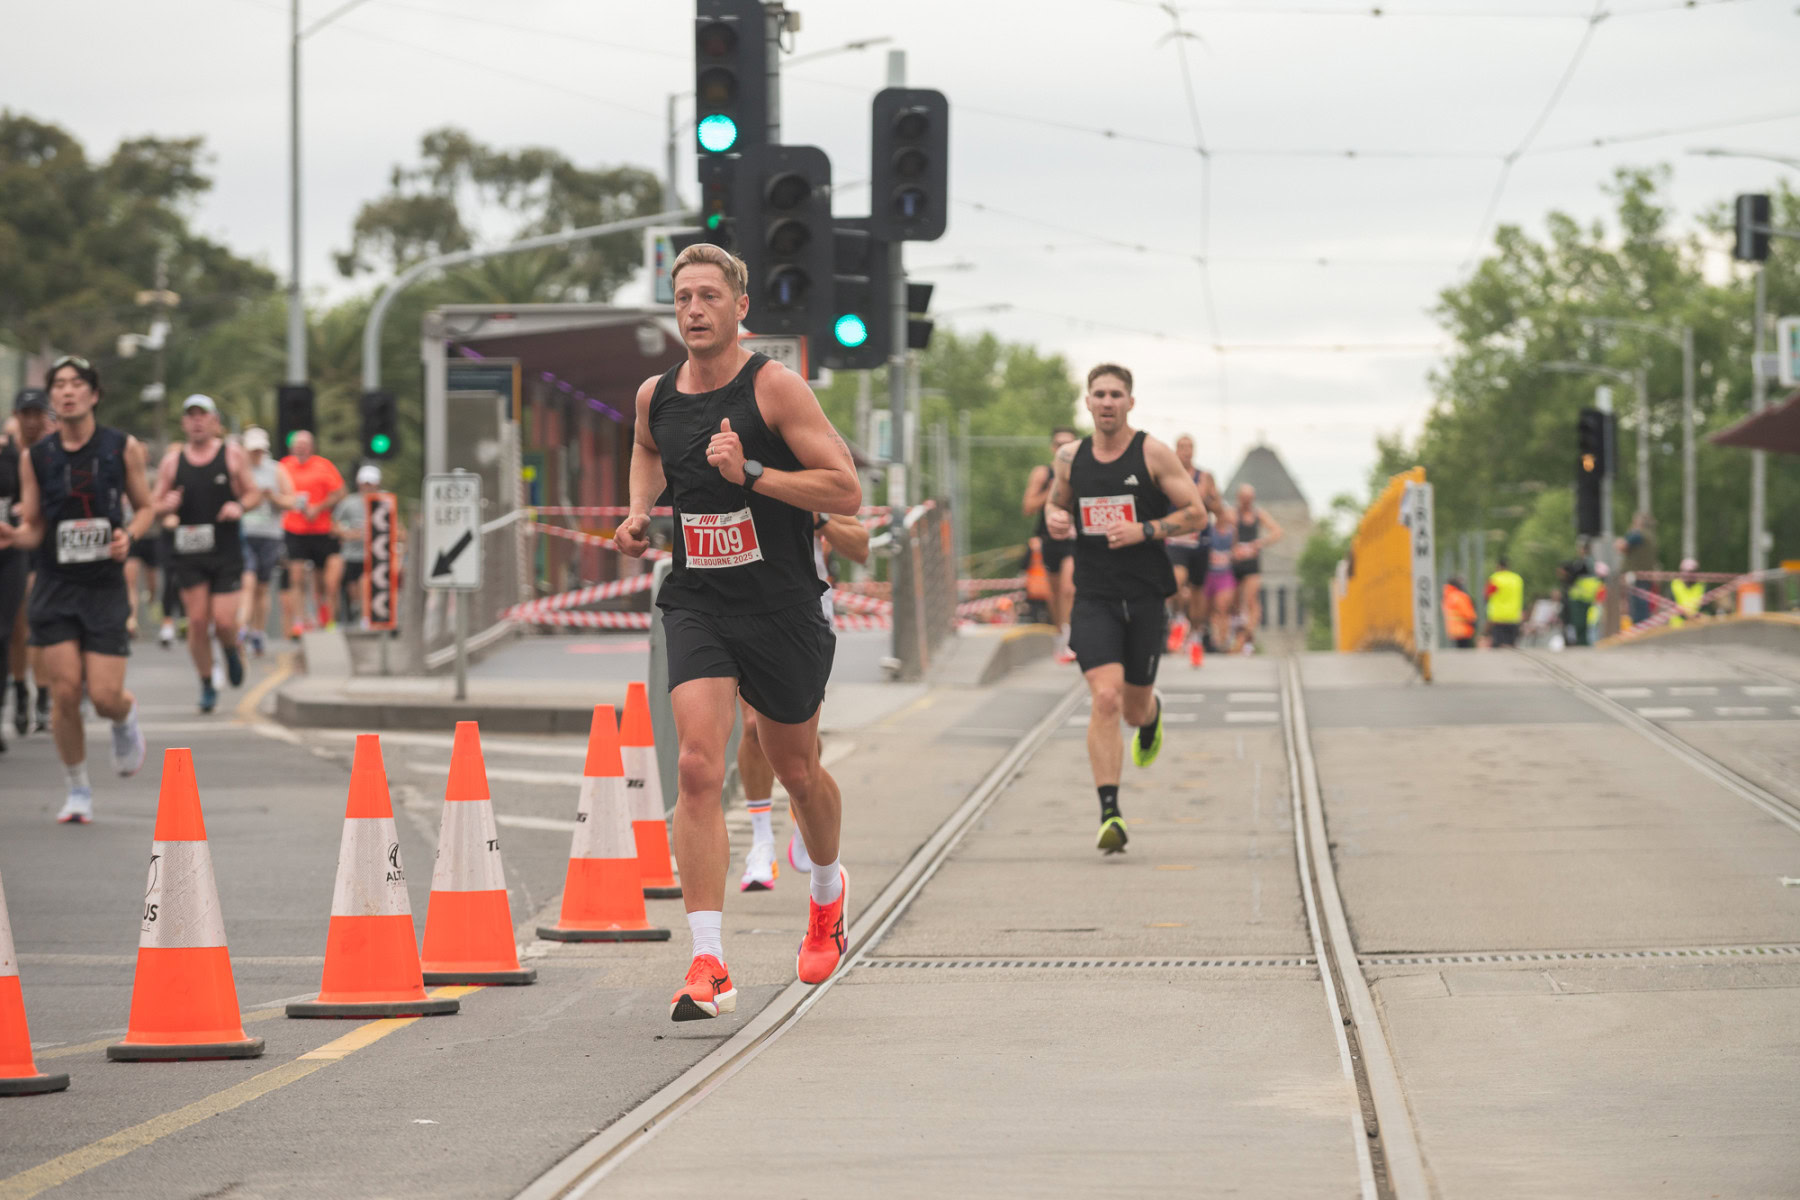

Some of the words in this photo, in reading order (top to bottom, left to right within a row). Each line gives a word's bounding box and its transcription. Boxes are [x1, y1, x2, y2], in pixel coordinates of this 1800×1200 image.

[434, 484, 471, 502] KEEP
[434, 506, 471, 526] LEFT
[1416, 488, 1430, 557] TRAM
[693, 526, 744, 555] 7709
[692, 556, 731, 566] MELBOURNE
[733, 552, 753, 564] 2025
[1417, 575, 1433, 647] ONLY
